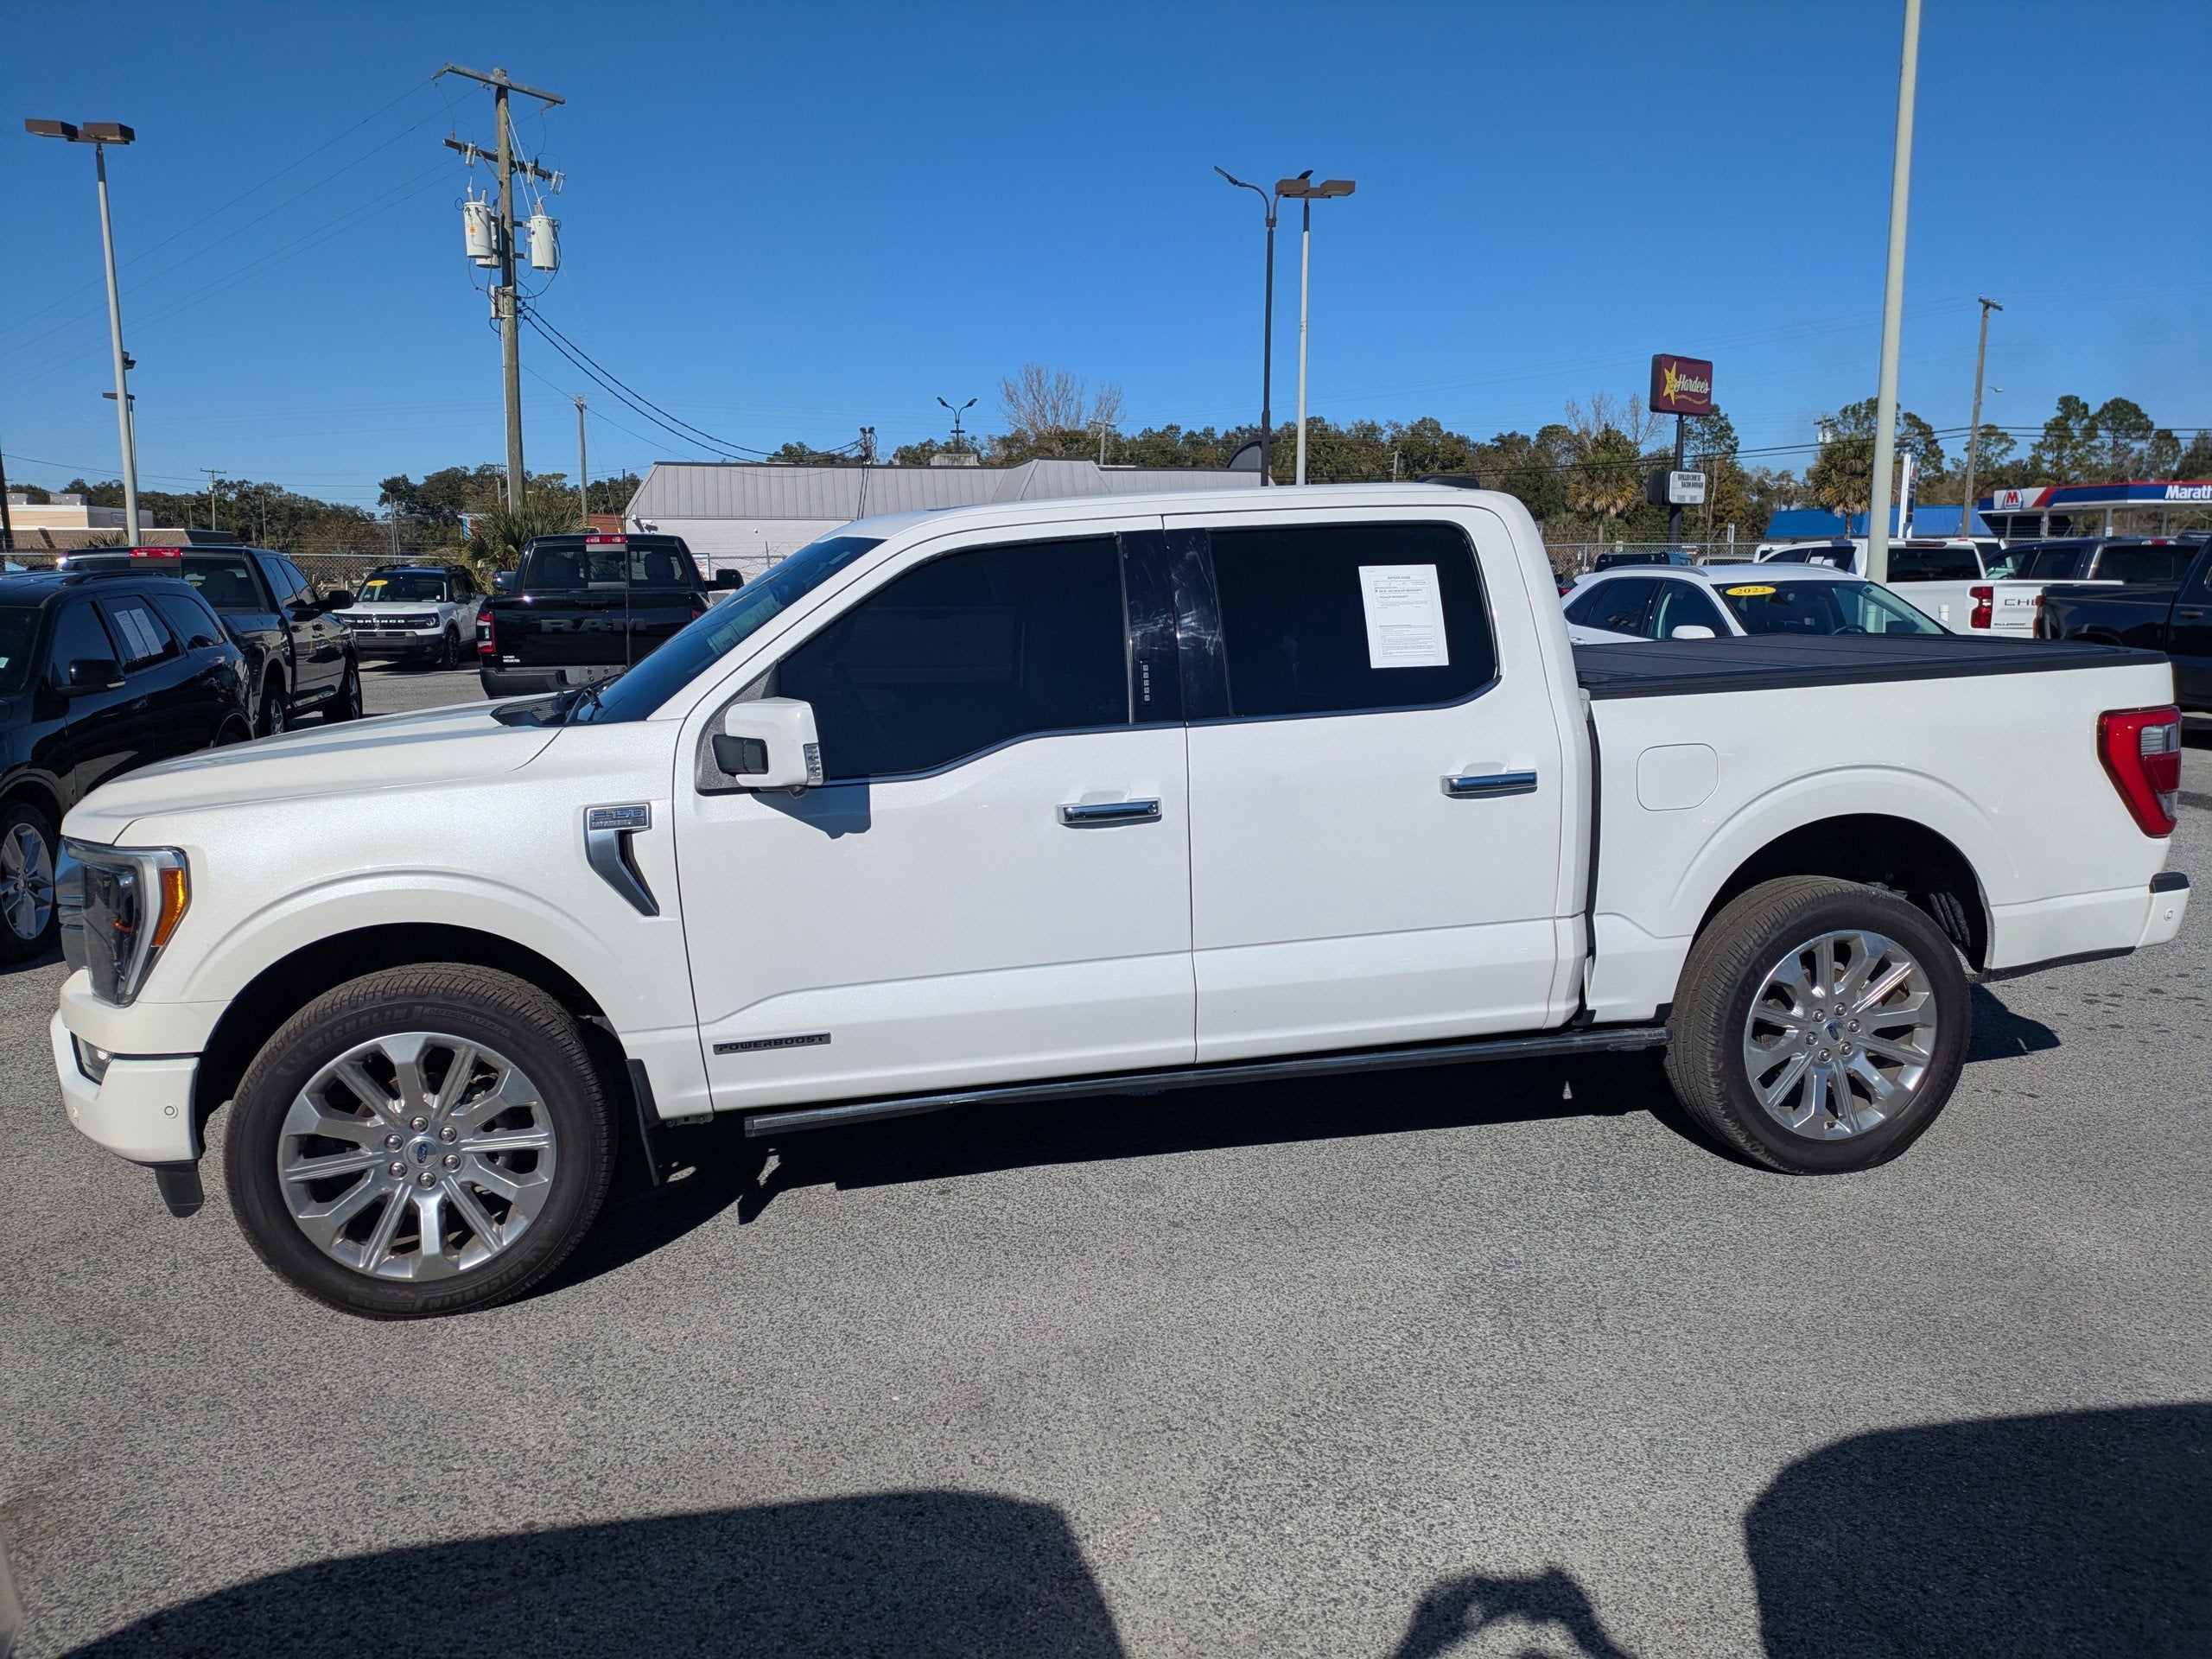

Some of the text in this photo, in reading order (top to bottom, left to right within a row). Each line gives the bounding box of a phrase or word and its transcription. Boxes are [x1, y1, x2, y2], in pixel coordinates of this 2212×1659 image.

[1674, 373, 1710, 393] Hardee's
[2006, 492, 2018, 503] M
[540, 618, 647, 632] RAM
[591, 807, 645, 821] F-150
[309, 1008, 407, 1051] MICHELIN
[719, 1036, 823, 1052] POWERBOOST
